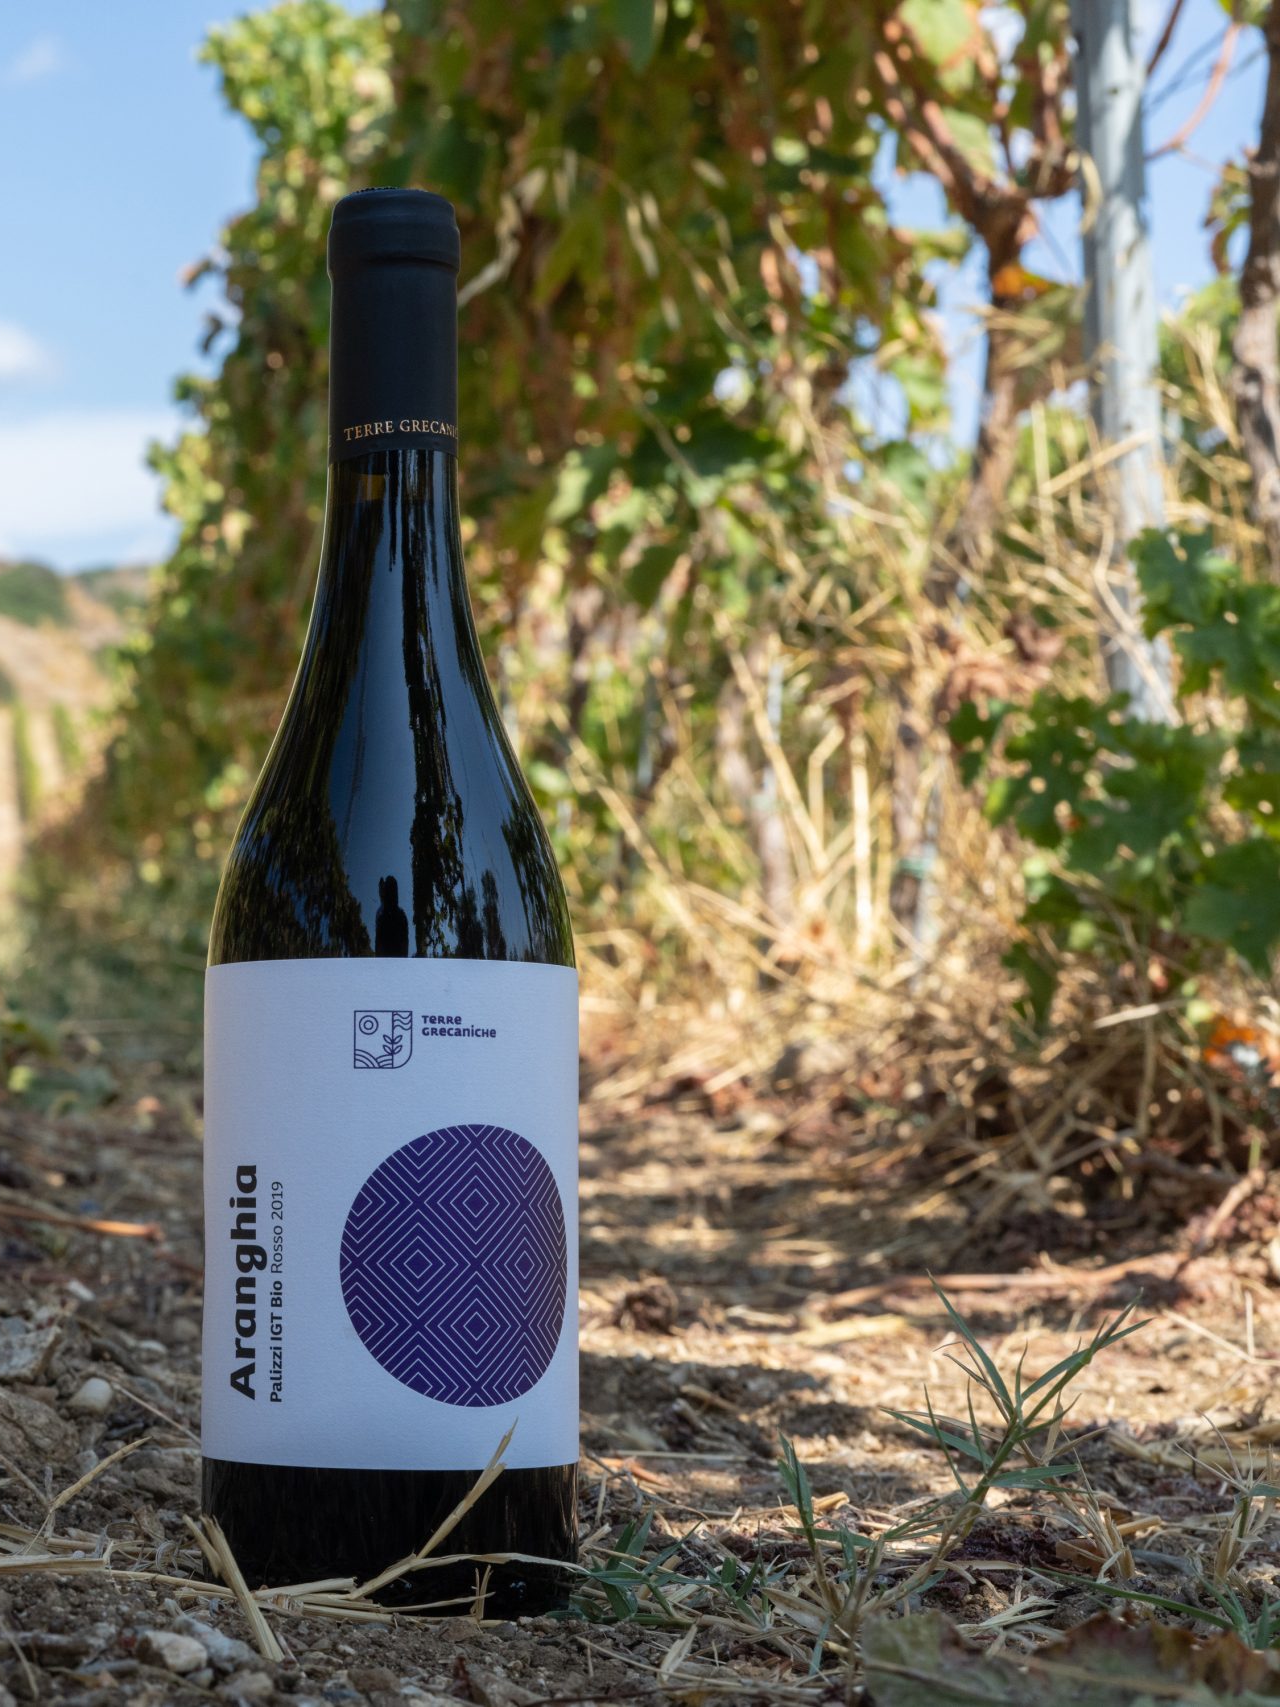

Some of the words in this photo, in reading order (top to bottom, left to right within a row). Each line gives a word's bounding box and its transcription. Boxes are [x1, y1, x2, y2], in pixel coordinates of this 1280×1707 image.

[344, 420, 394, 441] TERRE
[271, 1181, 284, 1221] 2019
[270, 1225, 283, 1274] Rosso
[229, 1165, 267, 1400] Aranghia
[270, 1280, 283, 1308] Bio
[270, 1312, 283, 1342] IGT
[270, 1346, 283, 1403] Palizzi
